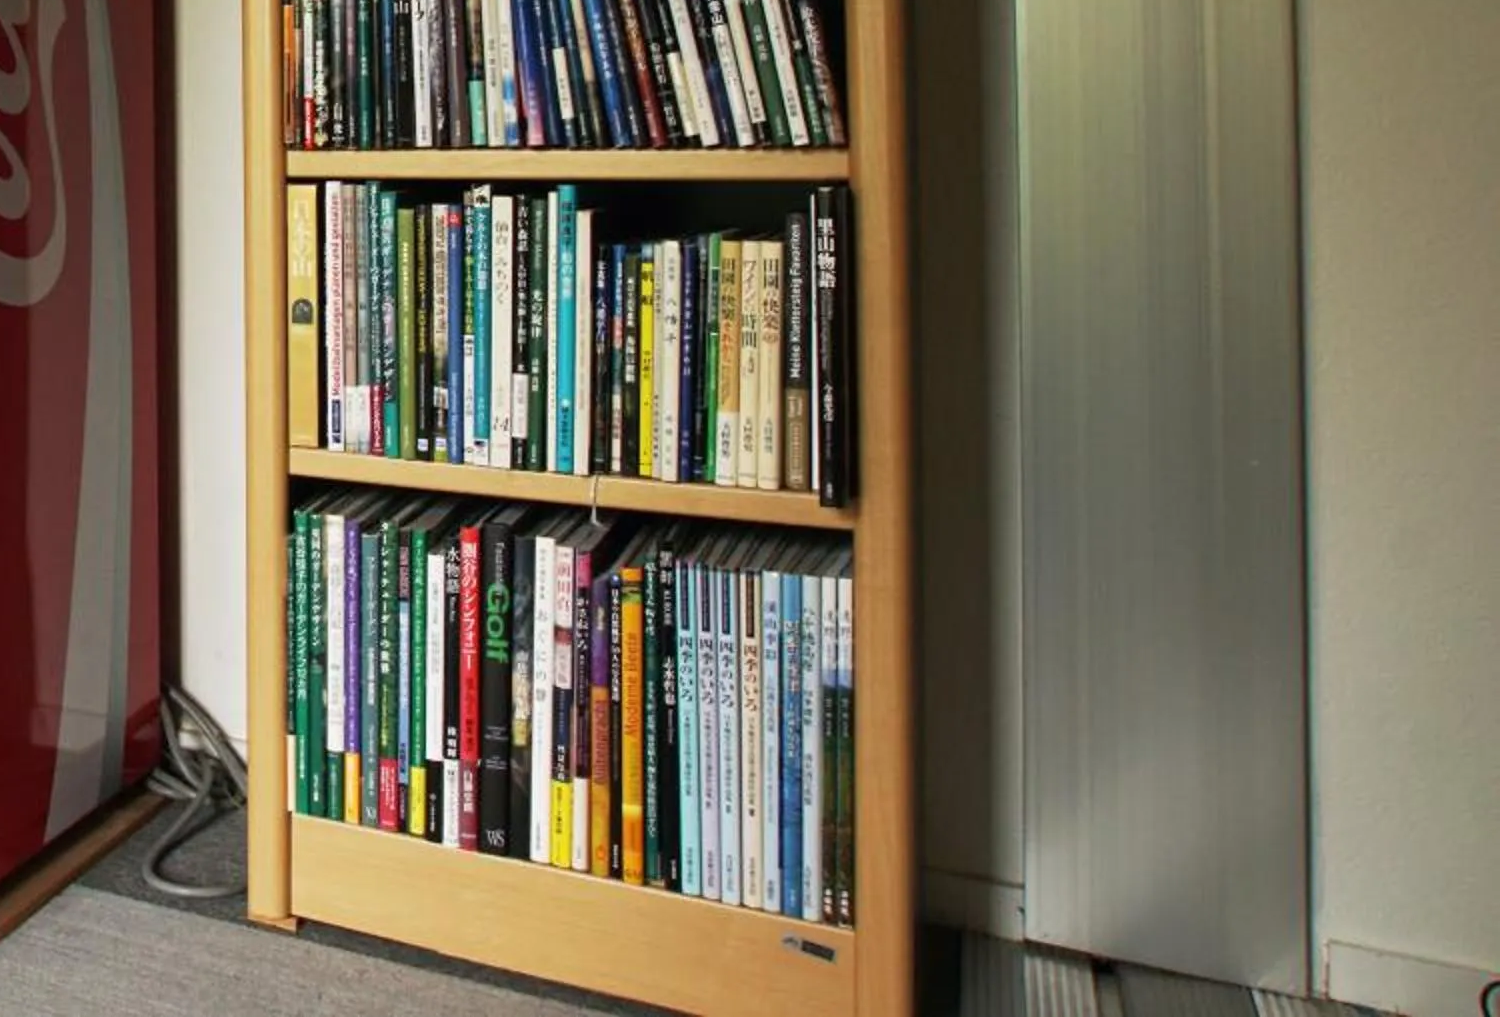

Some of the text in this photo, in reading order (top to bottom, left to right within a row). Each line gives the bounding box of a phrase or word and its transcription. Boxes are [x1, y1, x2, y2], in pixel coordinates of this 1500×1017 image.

[486, 582, 510, 665] Golf
[679, 636, 693, 702] 四季のいろ
[700, 638, 714, 705] 四季のいろ
[719, 640, 735, 708] 四季のいろ
[744, 644, 758, 712] 四季のいろ
